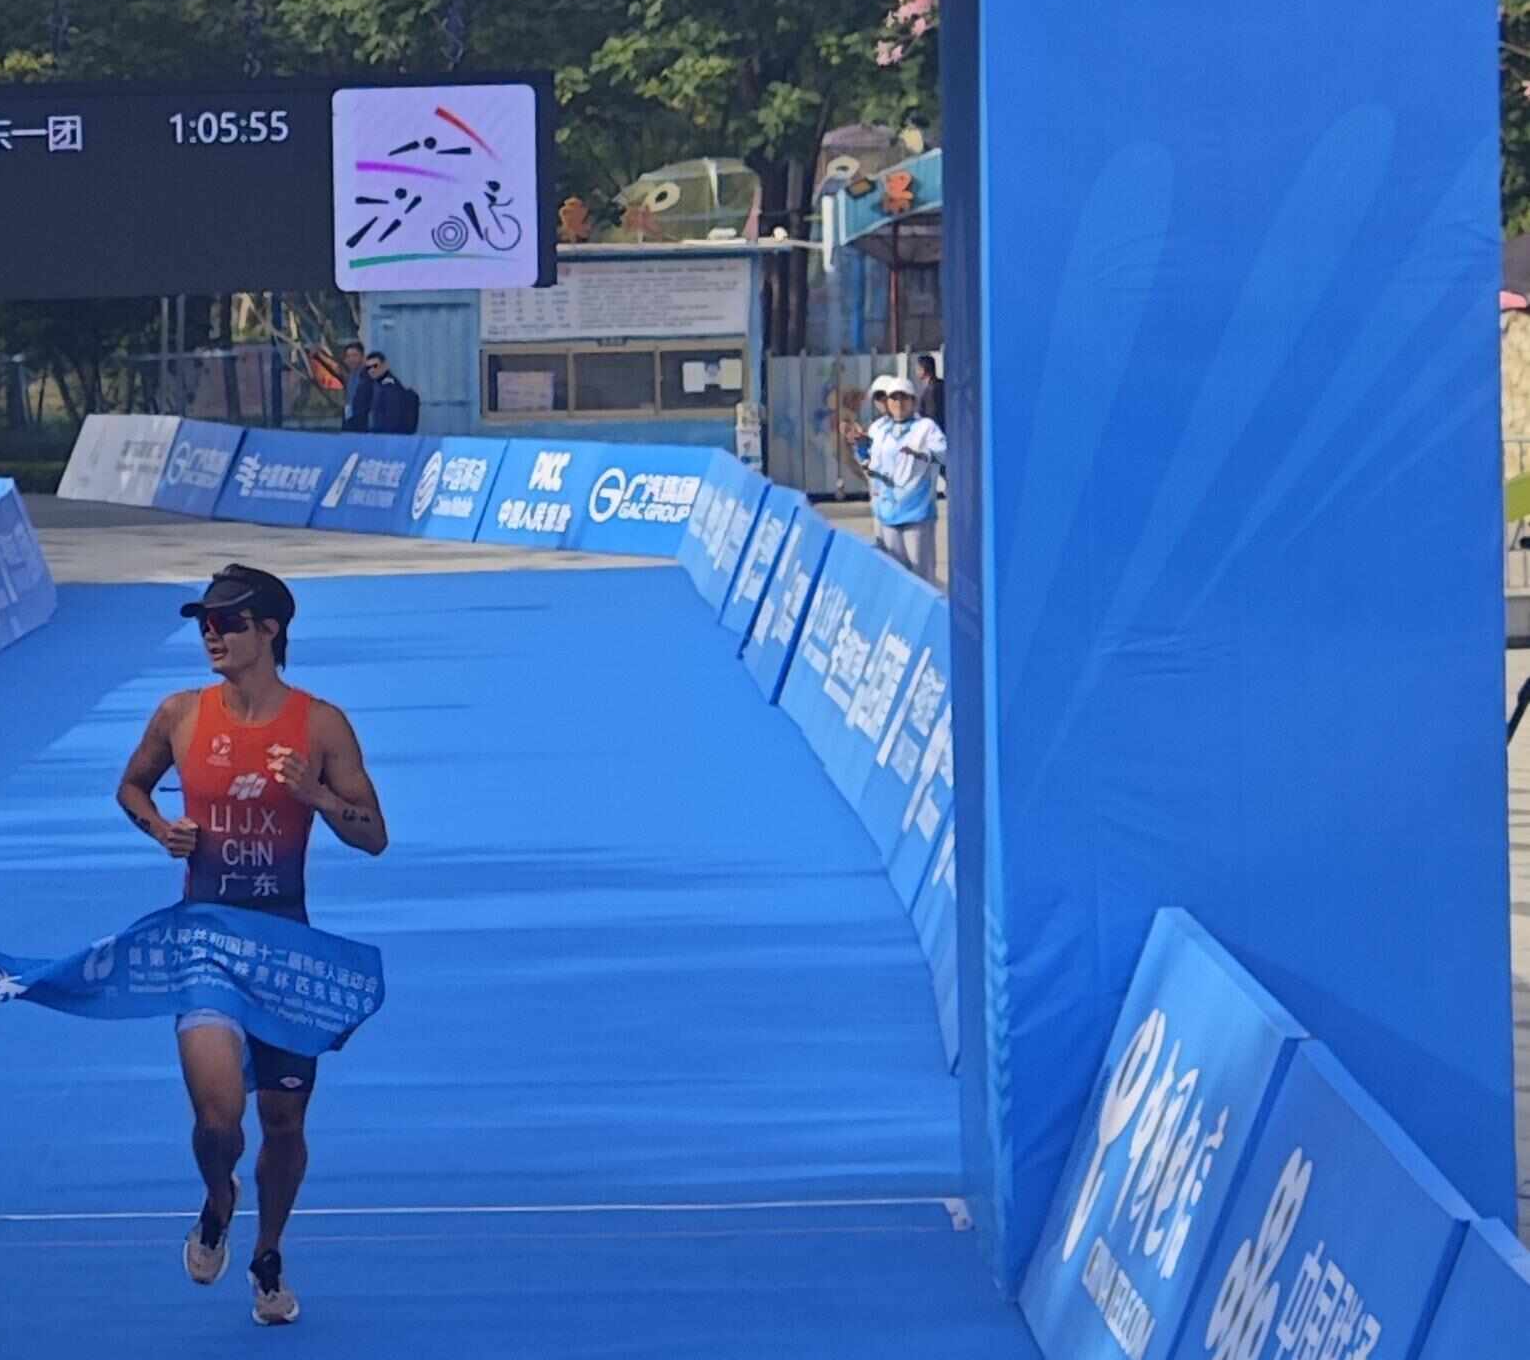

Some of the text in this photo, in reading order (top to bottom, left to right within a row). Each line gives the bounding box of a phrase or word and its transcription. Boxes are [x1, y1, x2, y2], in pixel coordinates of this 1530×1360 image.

[169, 110, 290, 144] 1:05:55
[210, 803, 232, 834] LI
[221, 838, 274, 867] CHN
[218, 872, 279, 897] 广东
[1108, 1038, 1229, 1279] 中国电信
